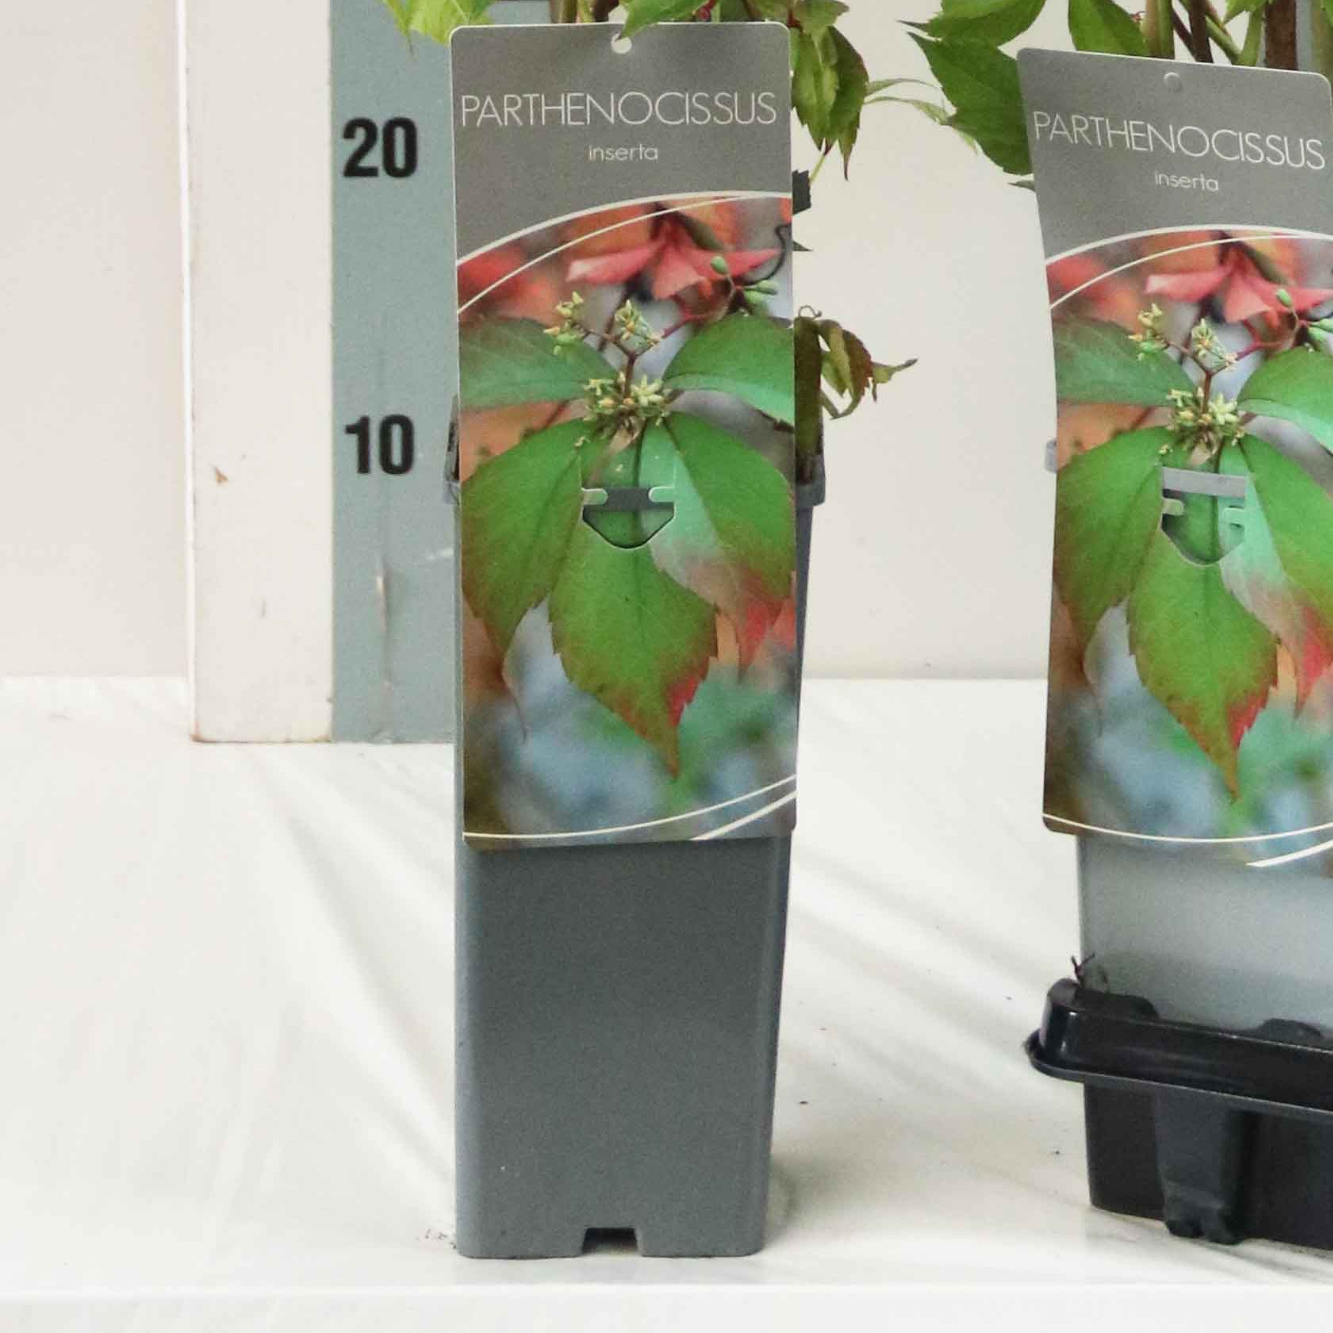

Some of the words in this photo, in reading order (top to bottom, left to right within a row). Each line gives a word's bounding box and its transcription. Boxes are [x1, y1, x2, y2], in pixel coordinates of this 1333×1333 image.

[461, 91, 777, 127] PARTHENOCISSUS
[342, 117, 418, 179] 20
[589, 143, 659, 161] inserta
[1033, 111, 1326, 170] PARTHENOCISSUS
[1154, 171, 1219, 192] inserta
[345, 414, 414, 475] 10
